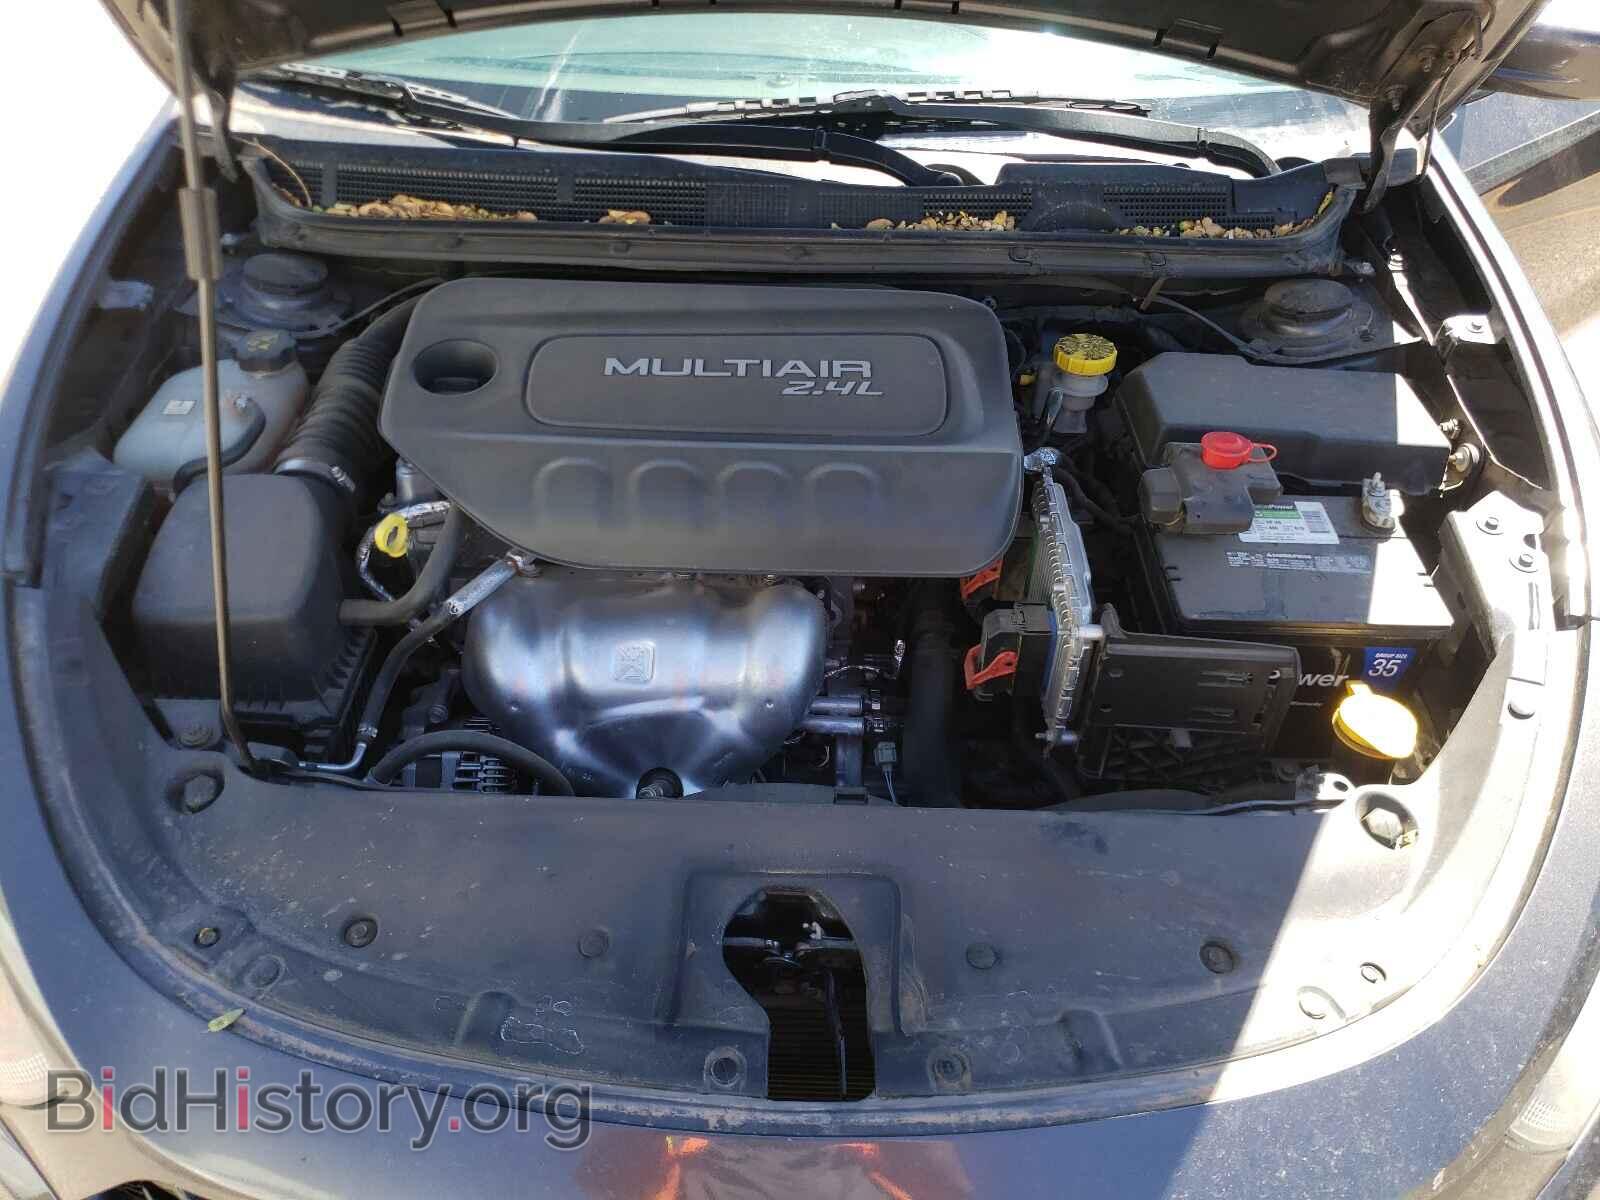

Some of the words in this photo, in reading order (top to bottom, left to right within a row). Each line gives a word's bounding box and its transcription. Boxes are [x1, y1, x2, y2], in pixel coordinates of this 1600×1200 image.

[604, 358, 872, 377] MULTIAIR
[781, 381, 884, 396] 2.4L
[1368, 659, 1401, 677] 35
[1298, 673, 1349, 687] wer
